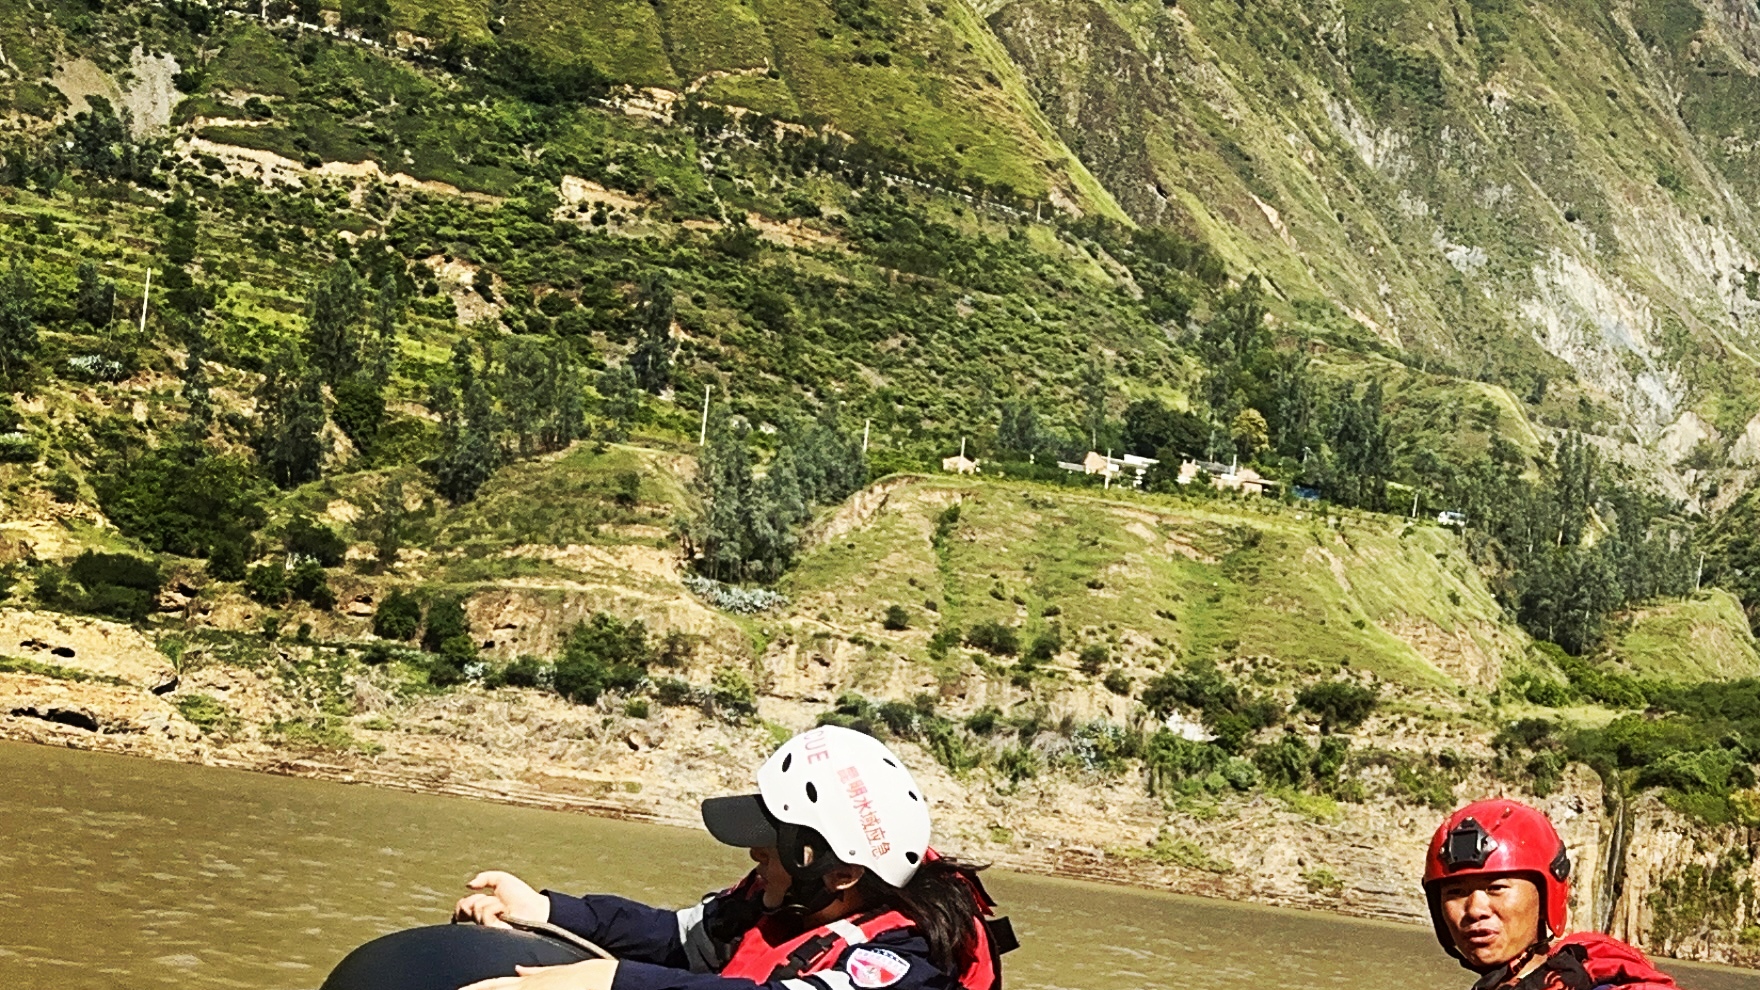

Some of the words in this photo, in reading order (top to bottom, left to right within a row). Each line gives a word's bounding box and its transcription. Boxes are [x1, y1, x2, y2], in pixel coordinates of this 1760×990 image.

[836, 766, 892, 861] 昆明水域应急
